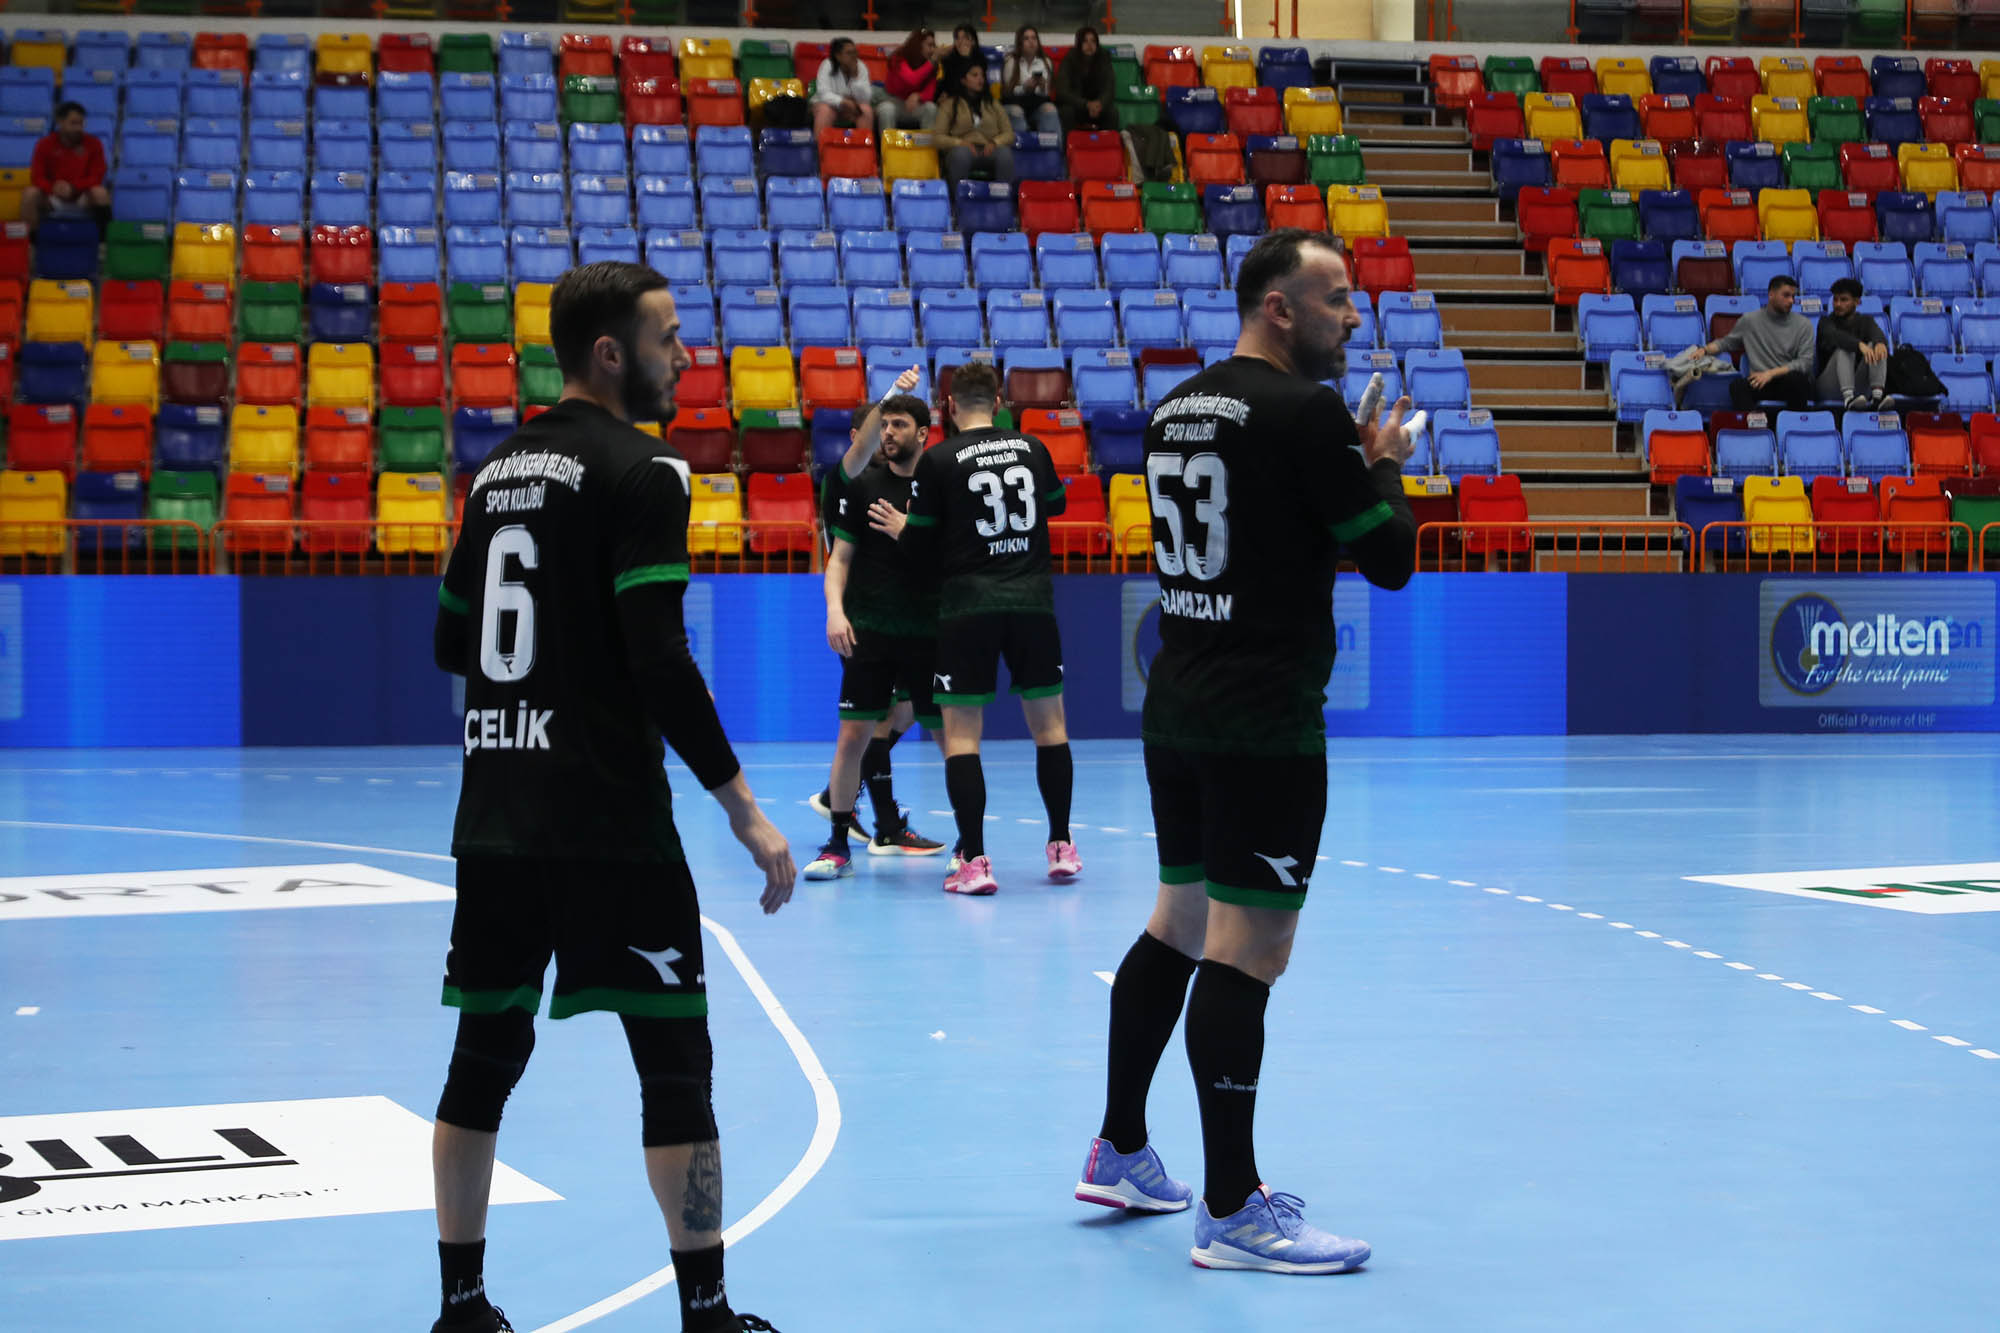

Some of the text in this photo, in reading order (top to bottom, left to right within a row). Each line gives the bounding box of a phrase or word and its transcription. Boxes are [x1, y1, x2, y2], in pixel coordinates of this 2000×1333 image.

[1214, 398, 1251, 427] BELEDİYE
[1163, 418, 1217, 441] SPOR KULÜBÜ
[543, 455, 586, 492] BELEDİYE
[976, 449, 1018, 467] SPOR KULÜBÜ
[486, 480, 546, 513] SPOR KULÜBÜ
[967, 465, 1036, 537] 33
[1147, 452, 1229, 581] 53
[480, 524, 538, 682] 6
[1160, 588, 1233, 621] RAMAZAN
[1810, 613, 1950, 657] molten
[1805, 662, 1949, 690] For the real game
[464, 700, 553, 756] ÇELİK
[1818, 712, 1937, 728] Official Partner of IHF
[0, 879, 393, 903] RTA
[0, 1128, 288, 1172] ILI
